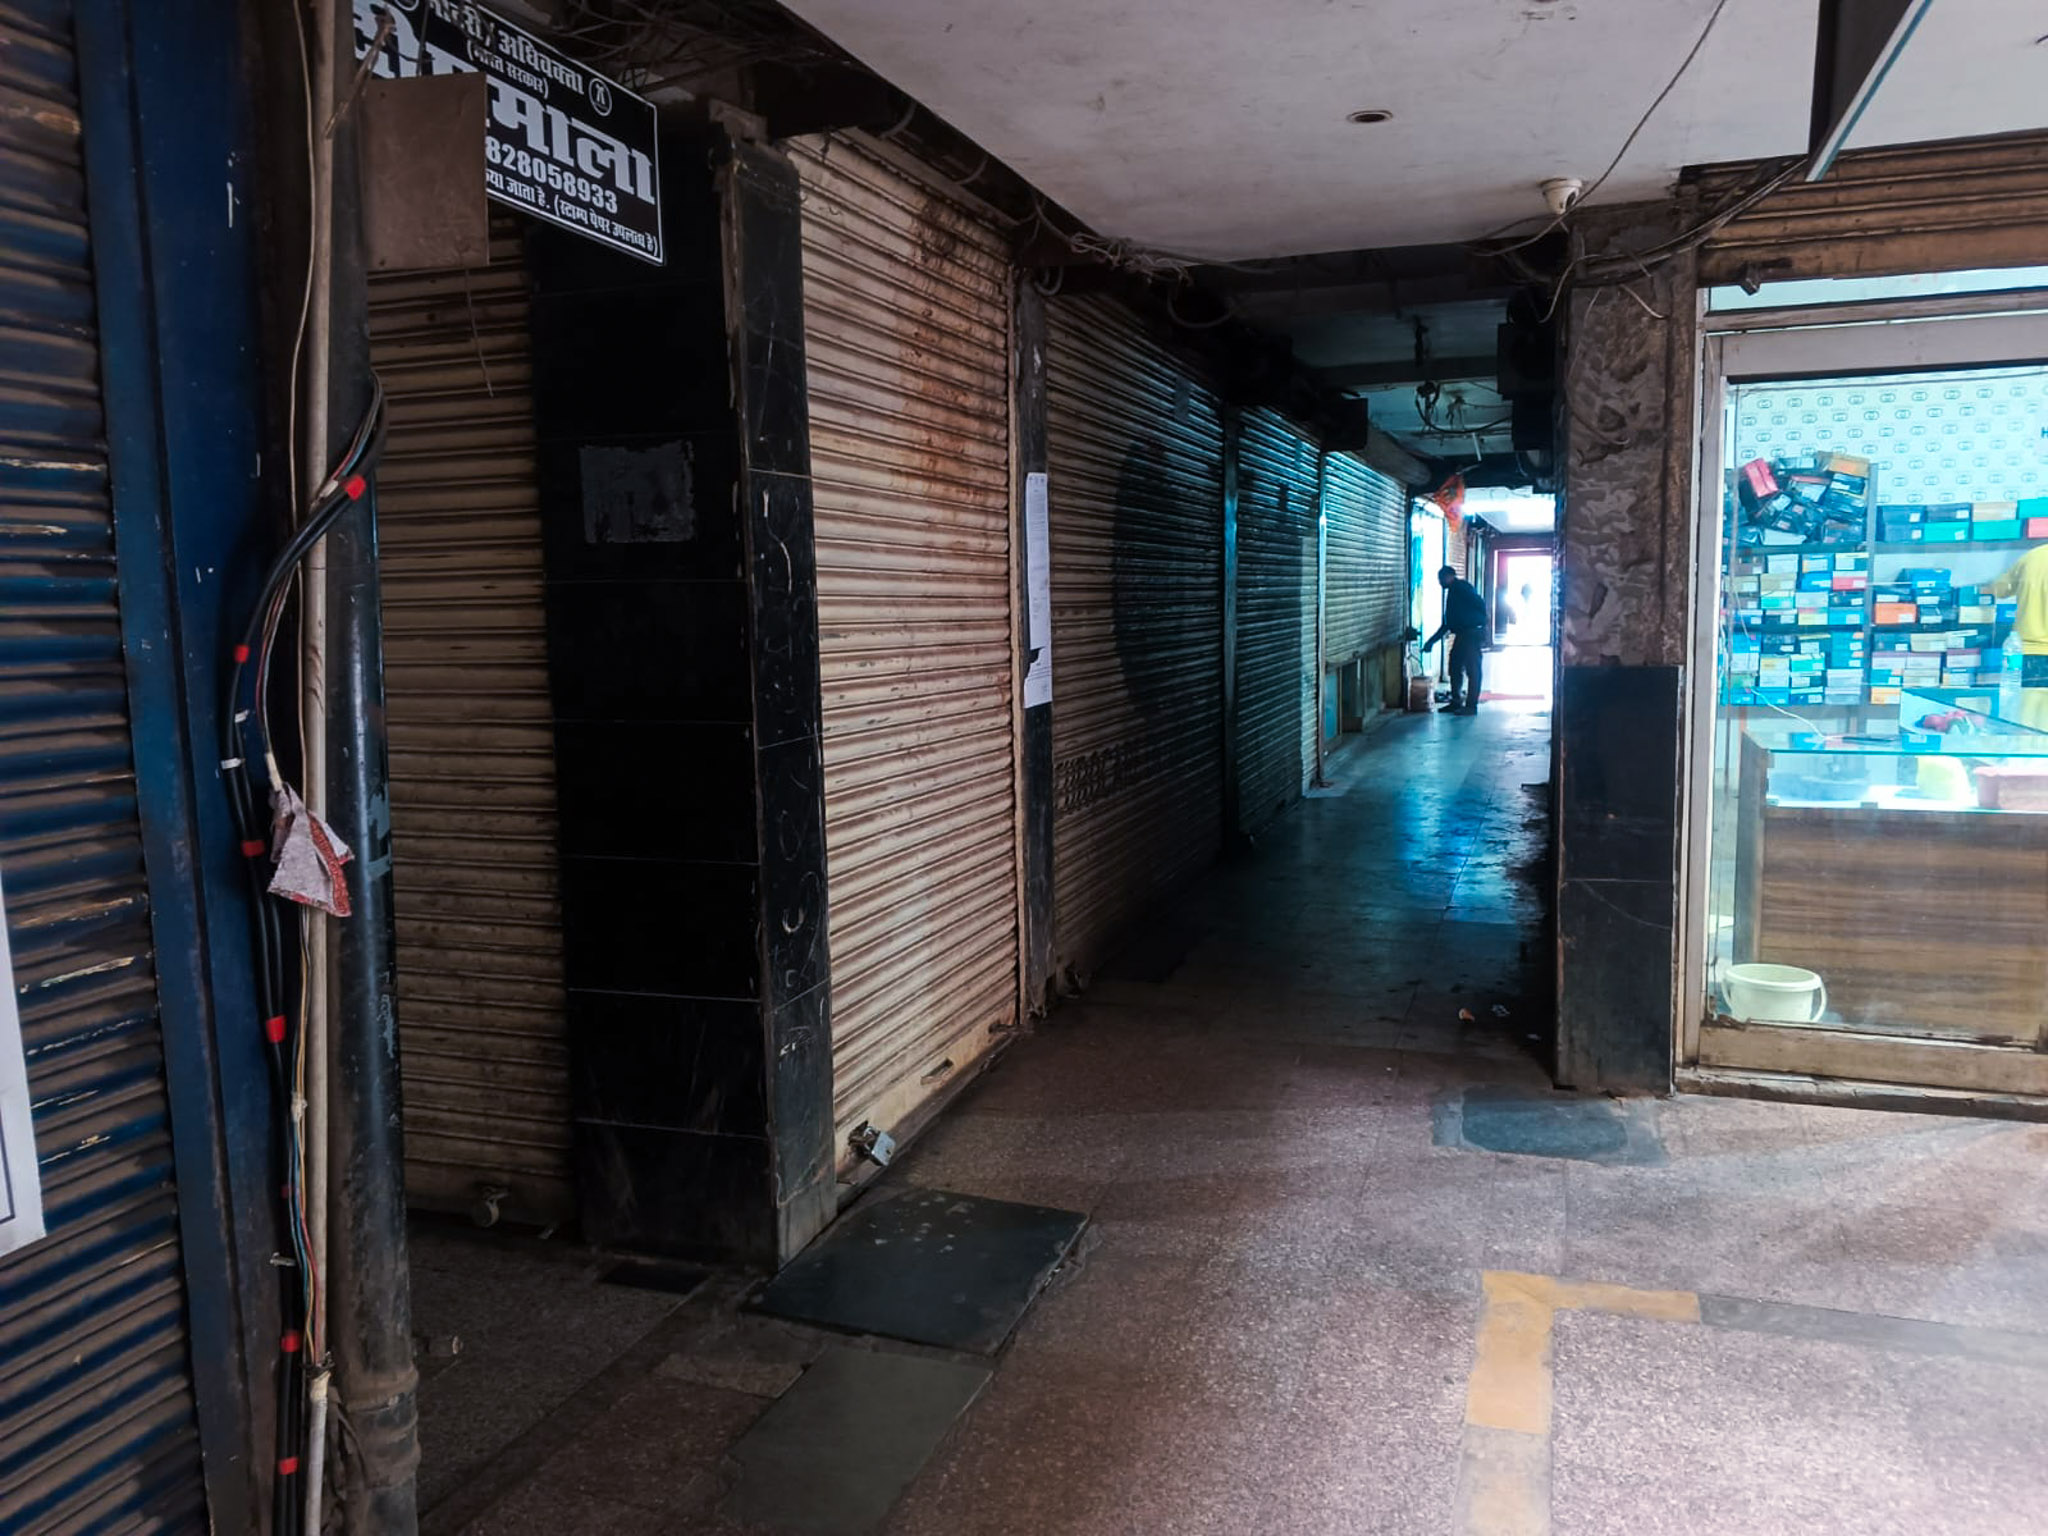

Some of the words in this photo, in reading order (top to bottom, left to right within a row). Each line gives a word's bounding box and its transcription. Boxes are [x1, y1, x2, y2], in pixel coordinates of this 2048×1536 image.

[497, 30, 585, 95] अधिवक्ता
[506, 177, 536, 203] जाता
[589, 208, 611, 234] पेपर
